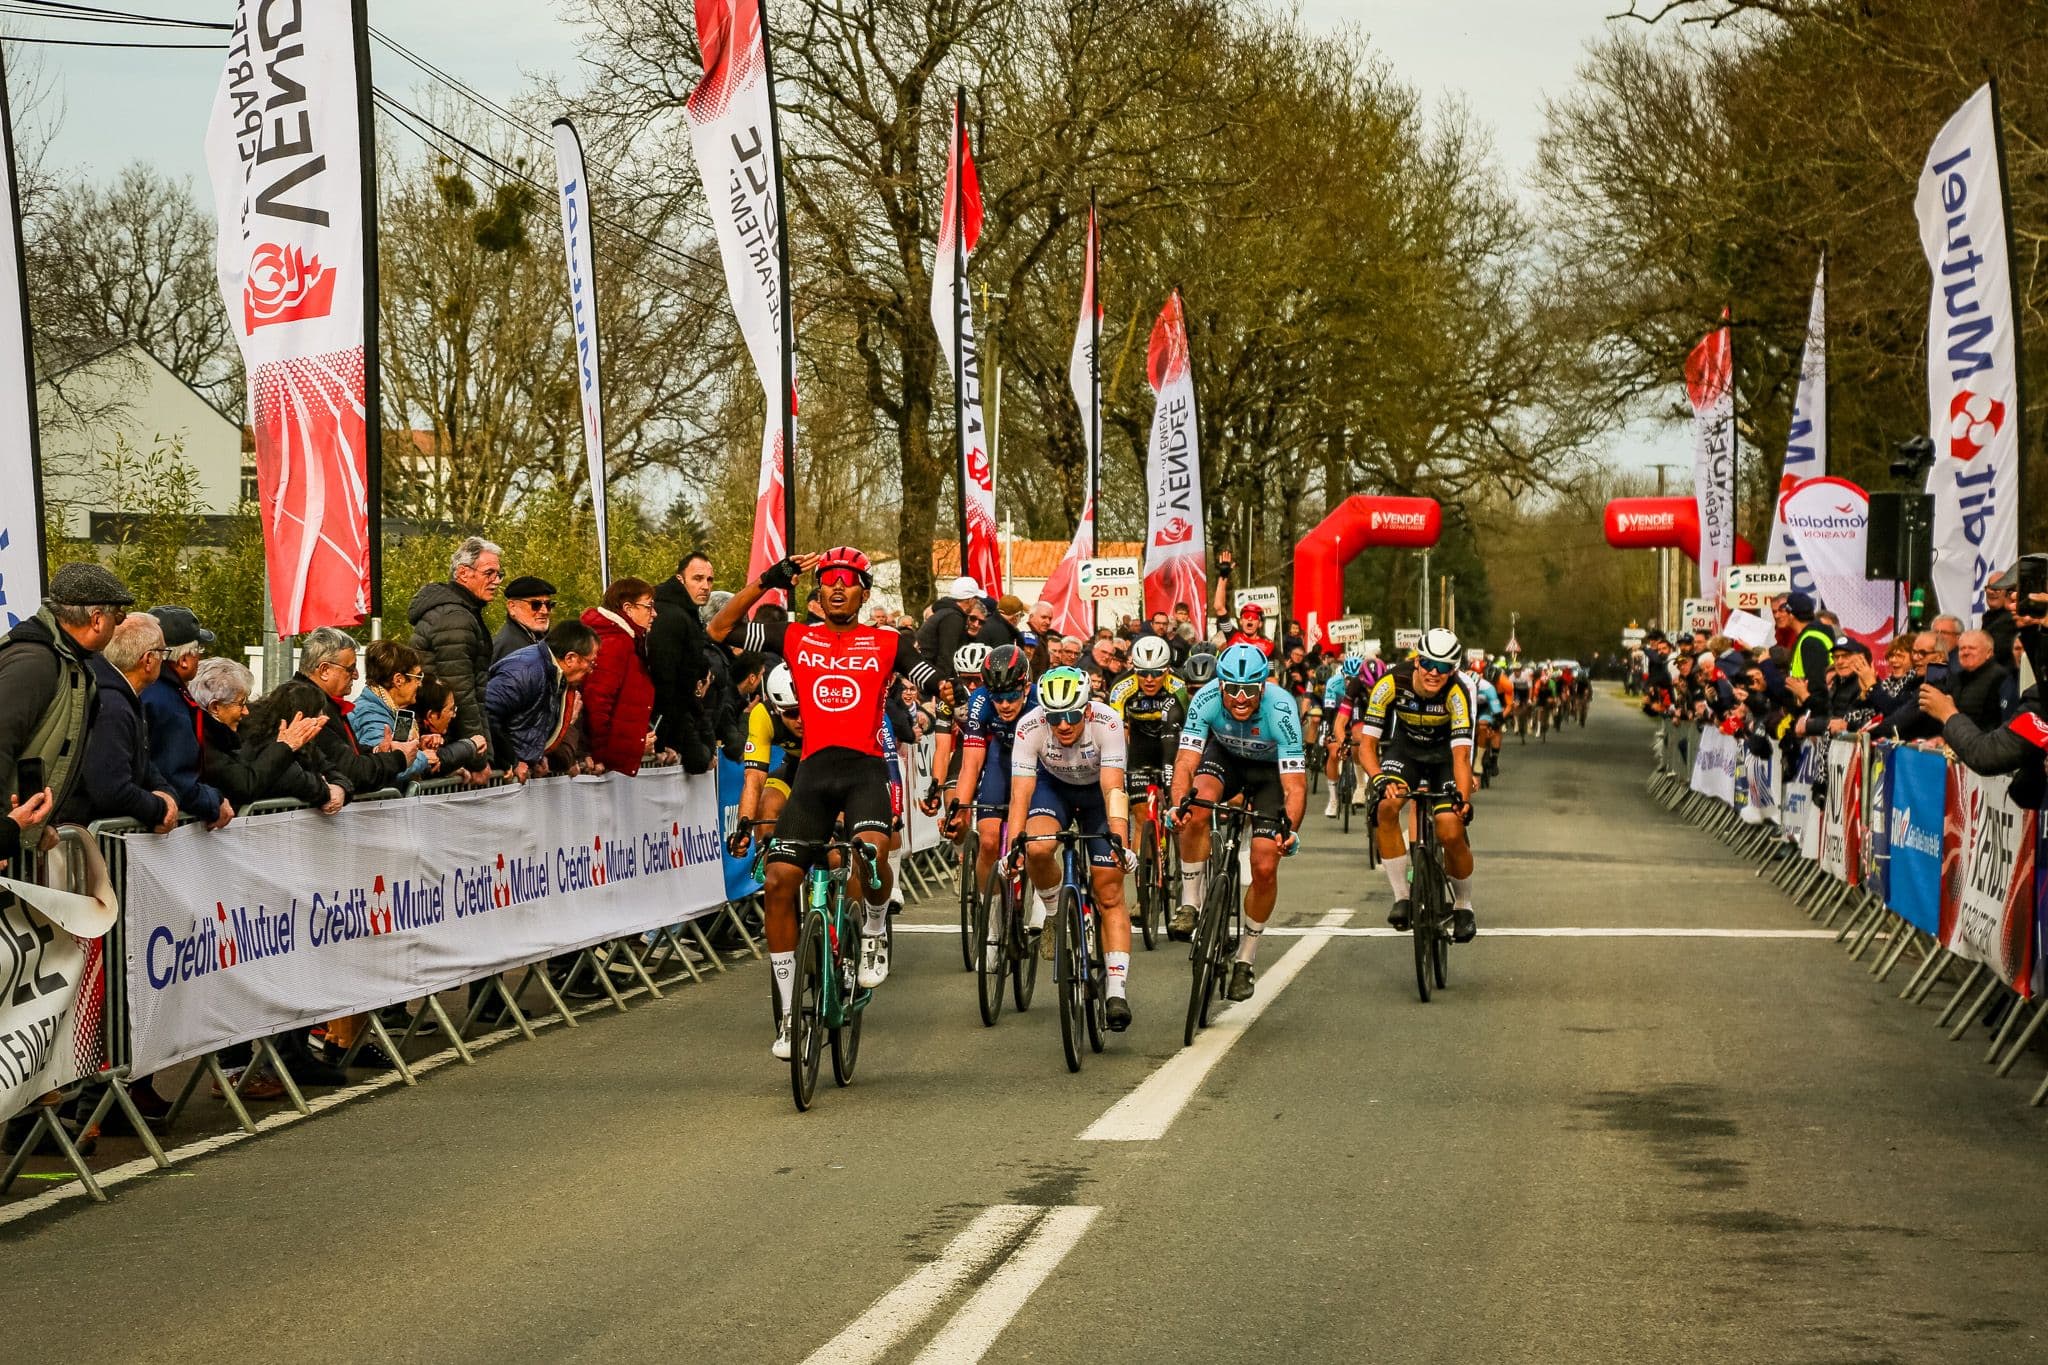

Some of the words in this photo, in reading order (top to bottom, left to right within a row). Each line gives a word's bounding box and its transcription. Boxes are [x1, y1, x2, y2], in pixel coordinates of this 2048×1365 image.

[1383, 511, 1425, 525] VENDÉE
[1629, 512, 1674, 525] VENDÉE
[1096, 567, 1135, 576] SERBA
[1745, 573, 1787, 582] SERBA
[1091, 585, 1109, 597] 25
[1114, 586, 1129, 596] m
[1739, 593, 1758, 606] 25
[1691, 618, 1705, 627] 50
[797, 650, 880, 672] ARKEA
[970, 694, 986, 720] PARIS
[882, 728, 896, 749] PARIS
[146, 916, 218, 990] Crédit
[231, 898, 297, 963] Mutuel
[310, 889, 370, 947] Crédit
[393, 874, 445, 931] Mutuel
[454, 865, 495, 918] Crédit
[510, 851, 550, 904] Mutuel
[556, 846, 592, 893] Crédit
[605, 836, 637, 883] Mutuel
[642, 831, 671, 875] Crédit
